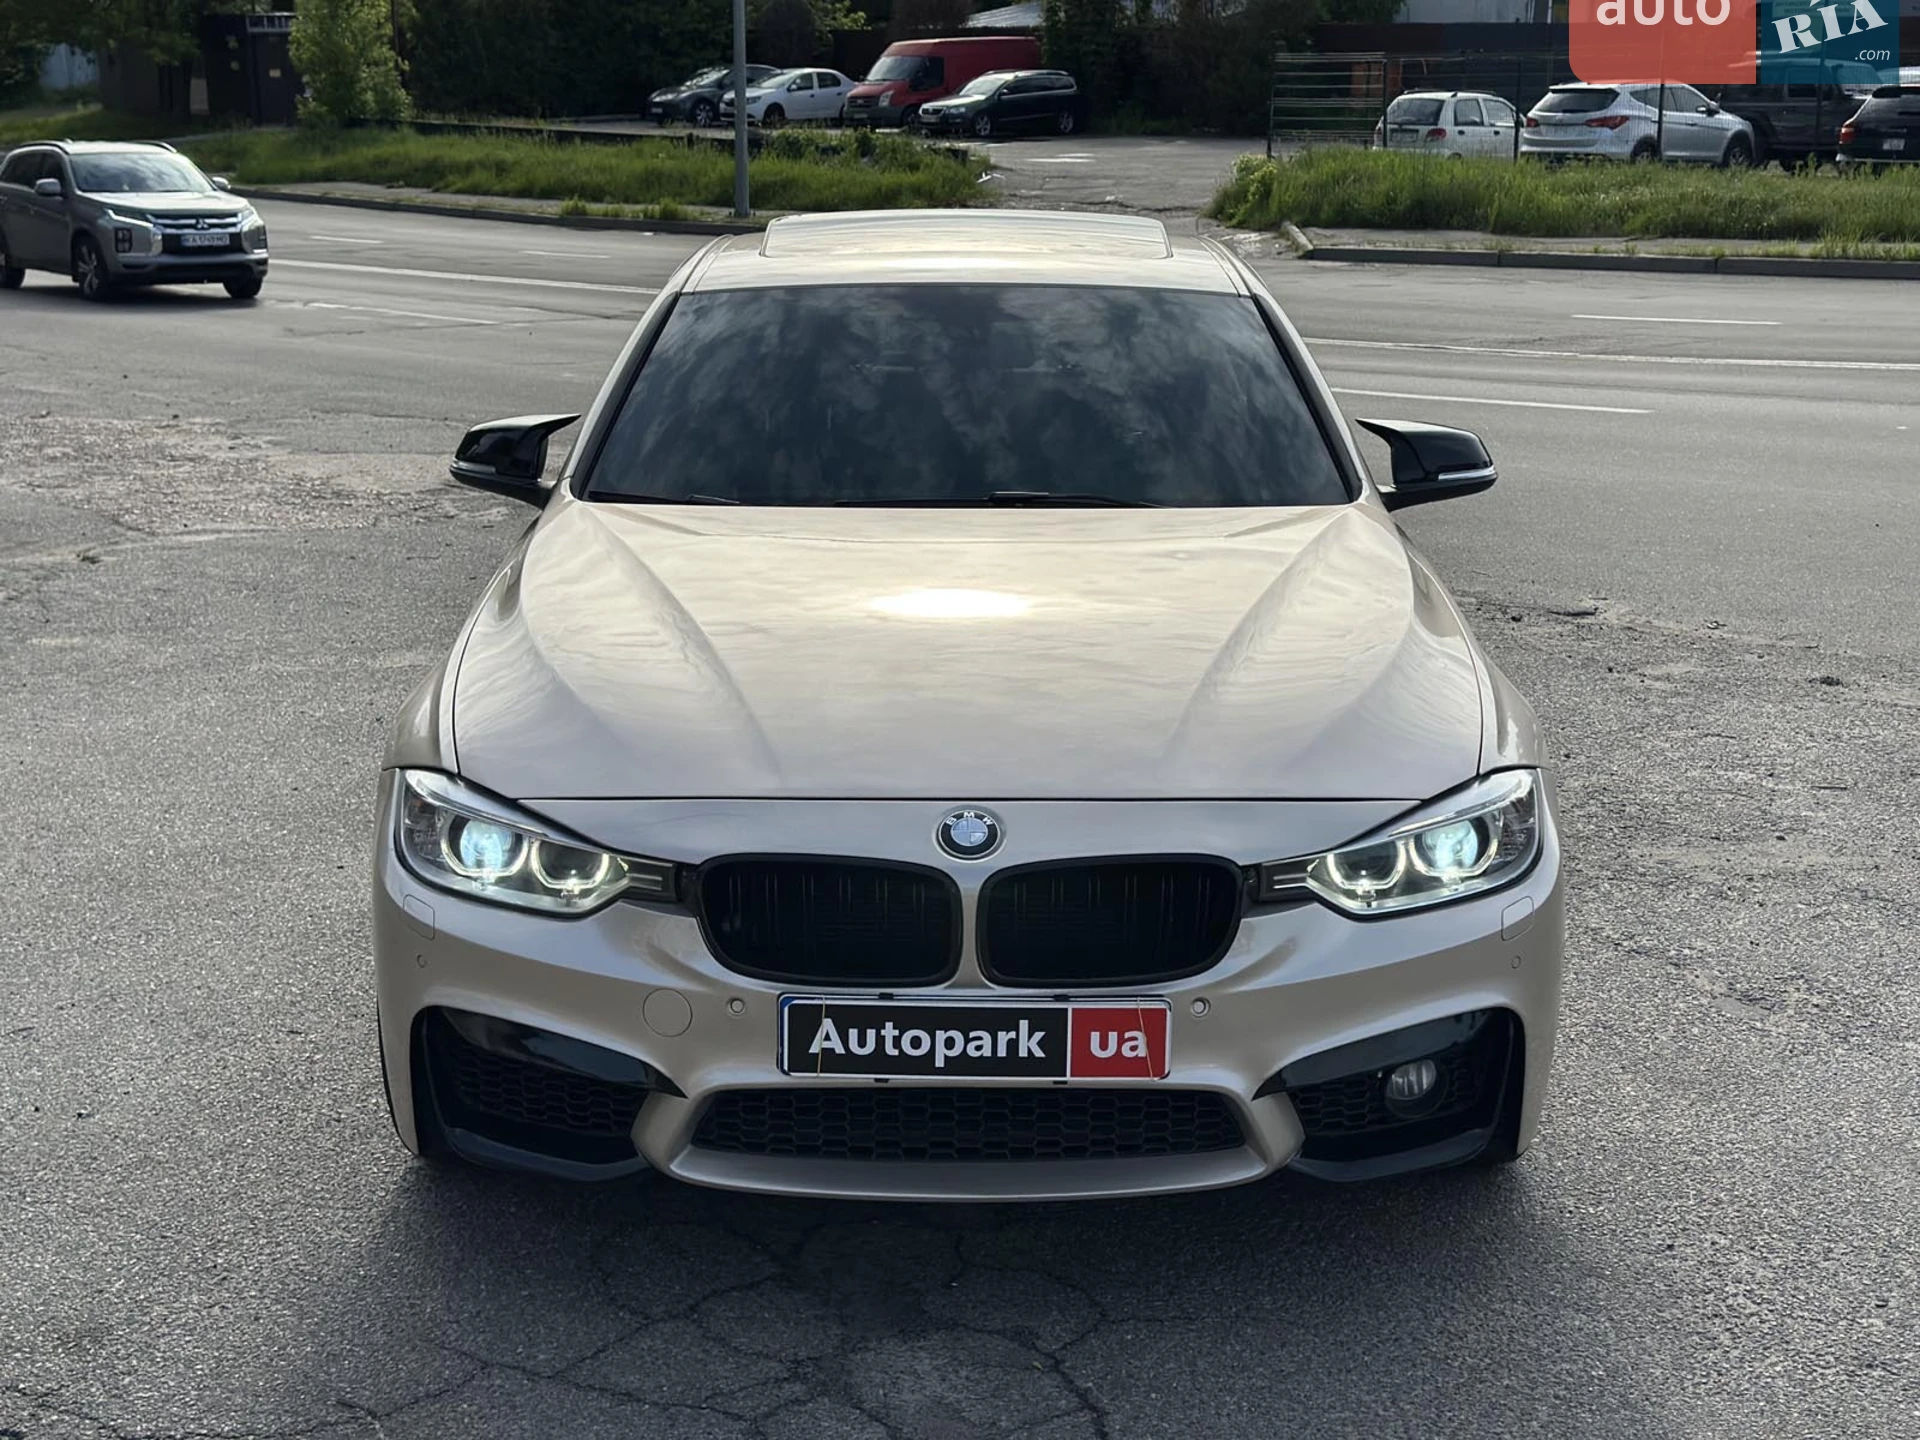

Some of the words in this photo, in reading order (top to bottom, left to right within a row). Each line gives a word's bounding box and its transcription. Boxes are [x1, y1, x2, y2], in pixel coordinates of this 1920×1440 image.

[945, 811, 994, 826] BMW
[808, 1018, 1046, 1068] Autopark
[1089, 1030, 1147, 1058] ua
